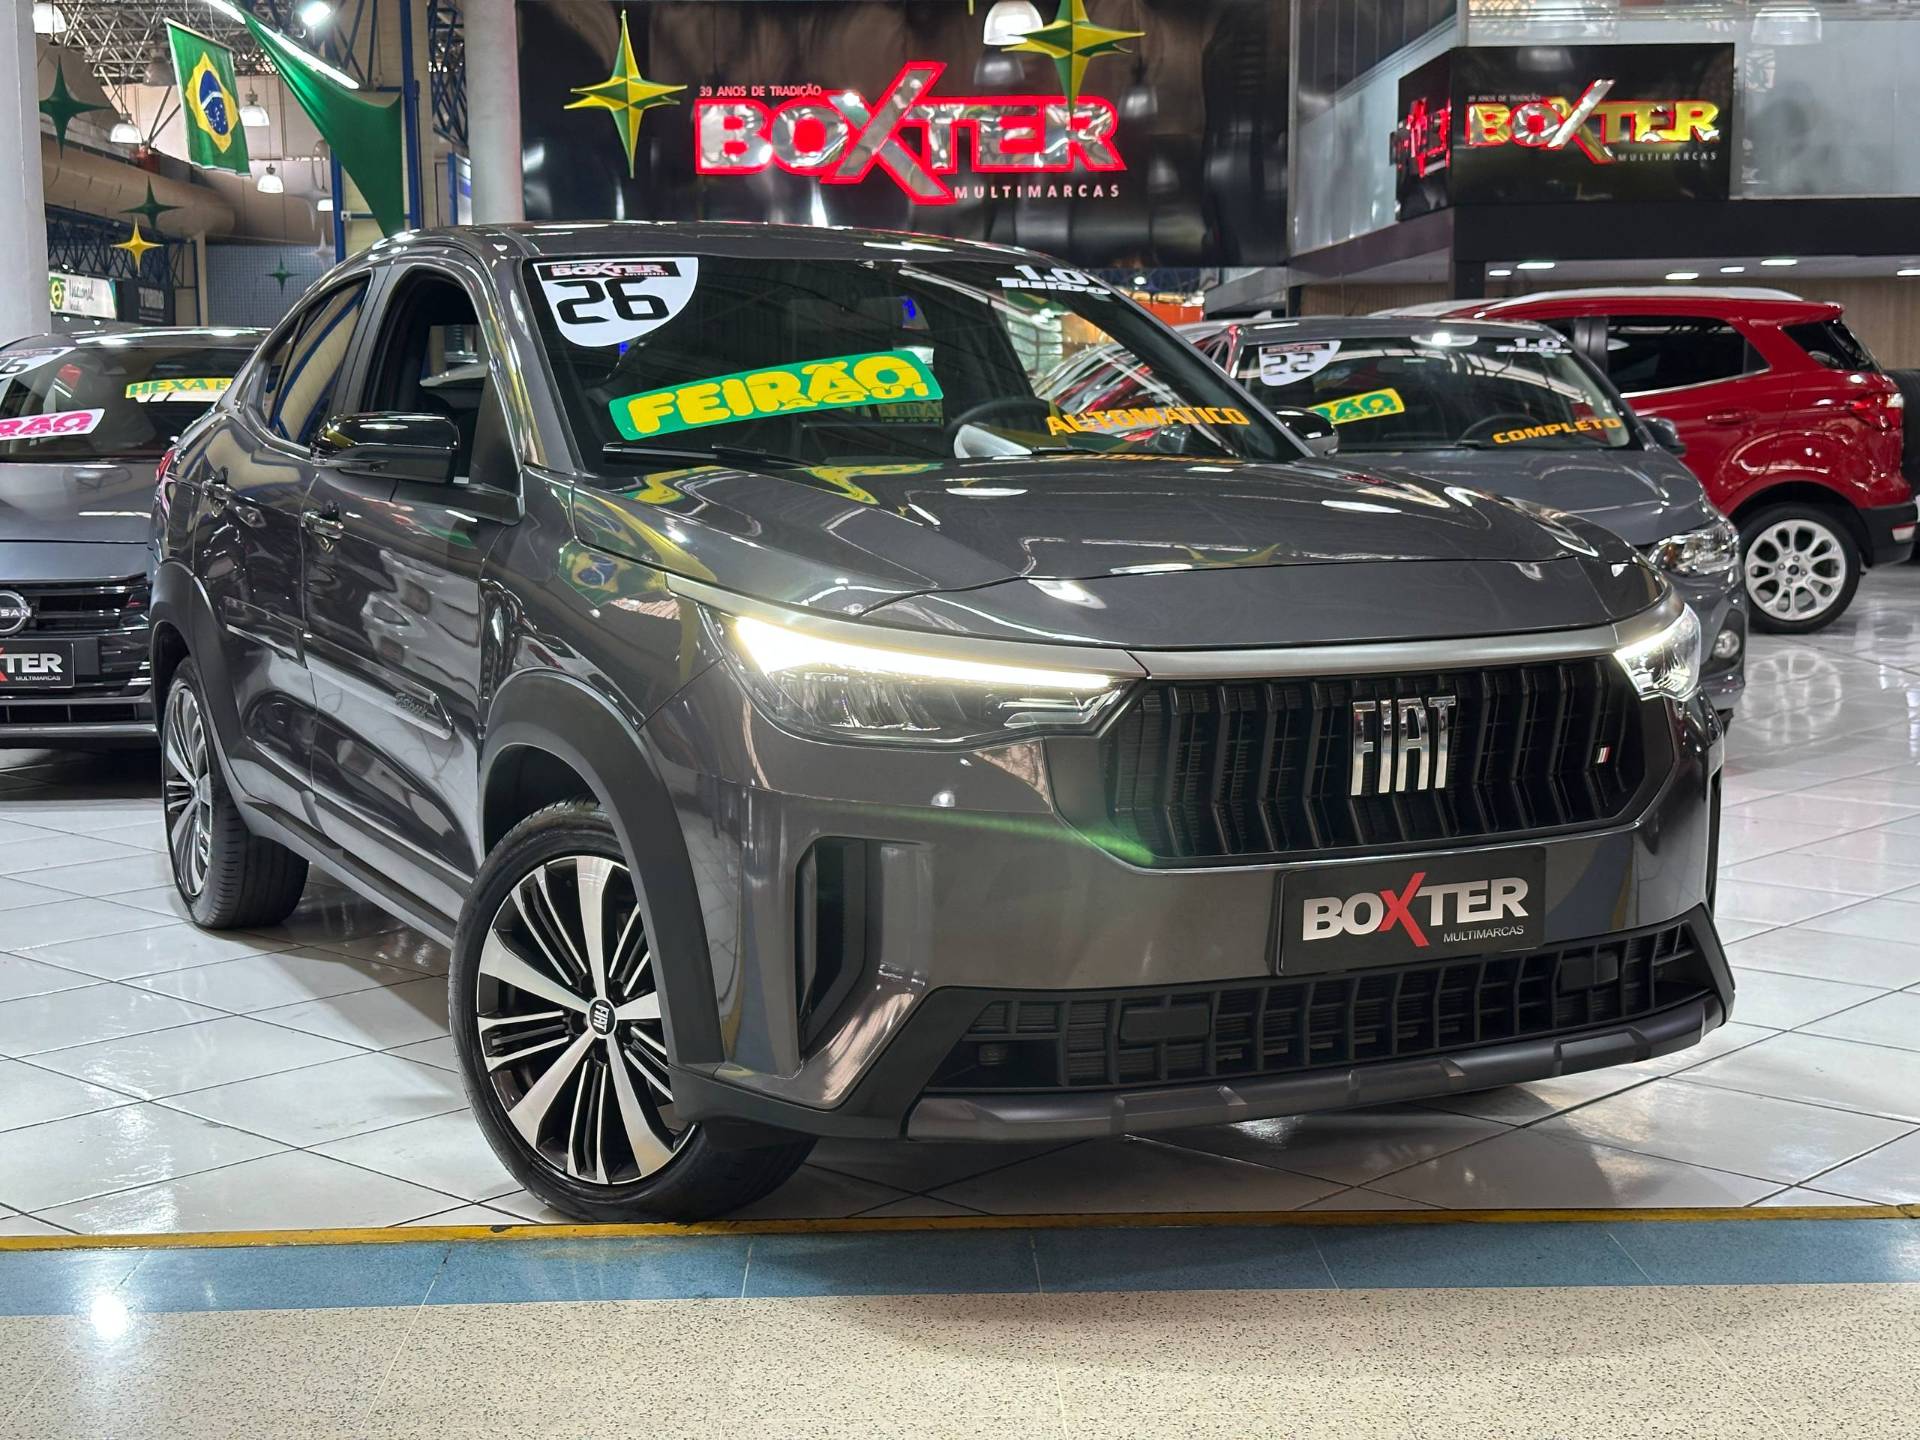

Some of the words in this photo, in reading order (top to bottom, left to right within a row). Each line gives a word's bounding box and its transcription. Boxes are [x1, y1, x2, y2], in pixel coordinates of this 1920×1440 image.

[700, 86, 713, 97] 39
[717, 86, 747, 97] ANOS
[751, 86, 766, 97] DE
[769, 83, 822, 98] TRADIÇÃO
[695, 61, 1127, 206] BOXTER
[1464, 79, 1721, 165] BOXTER
[1617, 152, 1718, 162] MULTIMARCAS
[954, 184, 1120, 199] MULTIMARCAS
[551, 262, 666, 277] BOXTER
[1014, 265, 1090, 285] 1.0
[552, 277, 670, 325] 26
[1514, 337, 1561, 348] 1.0
[1263, 352, 1315, 376] 22
[129, 379, 209, 396] HEXA
[628, 355, 924, 433] FEIRÃO
[1492, 417, 1622, 443] COMPLETO
[1350, 695, 1456, 796] FIAT
[1303, 872, 1529, 947] BOXTER
[1443, 925, 1525, 943] MULTIMARCAS
[593, 1004, 610, 1033] FIAT
